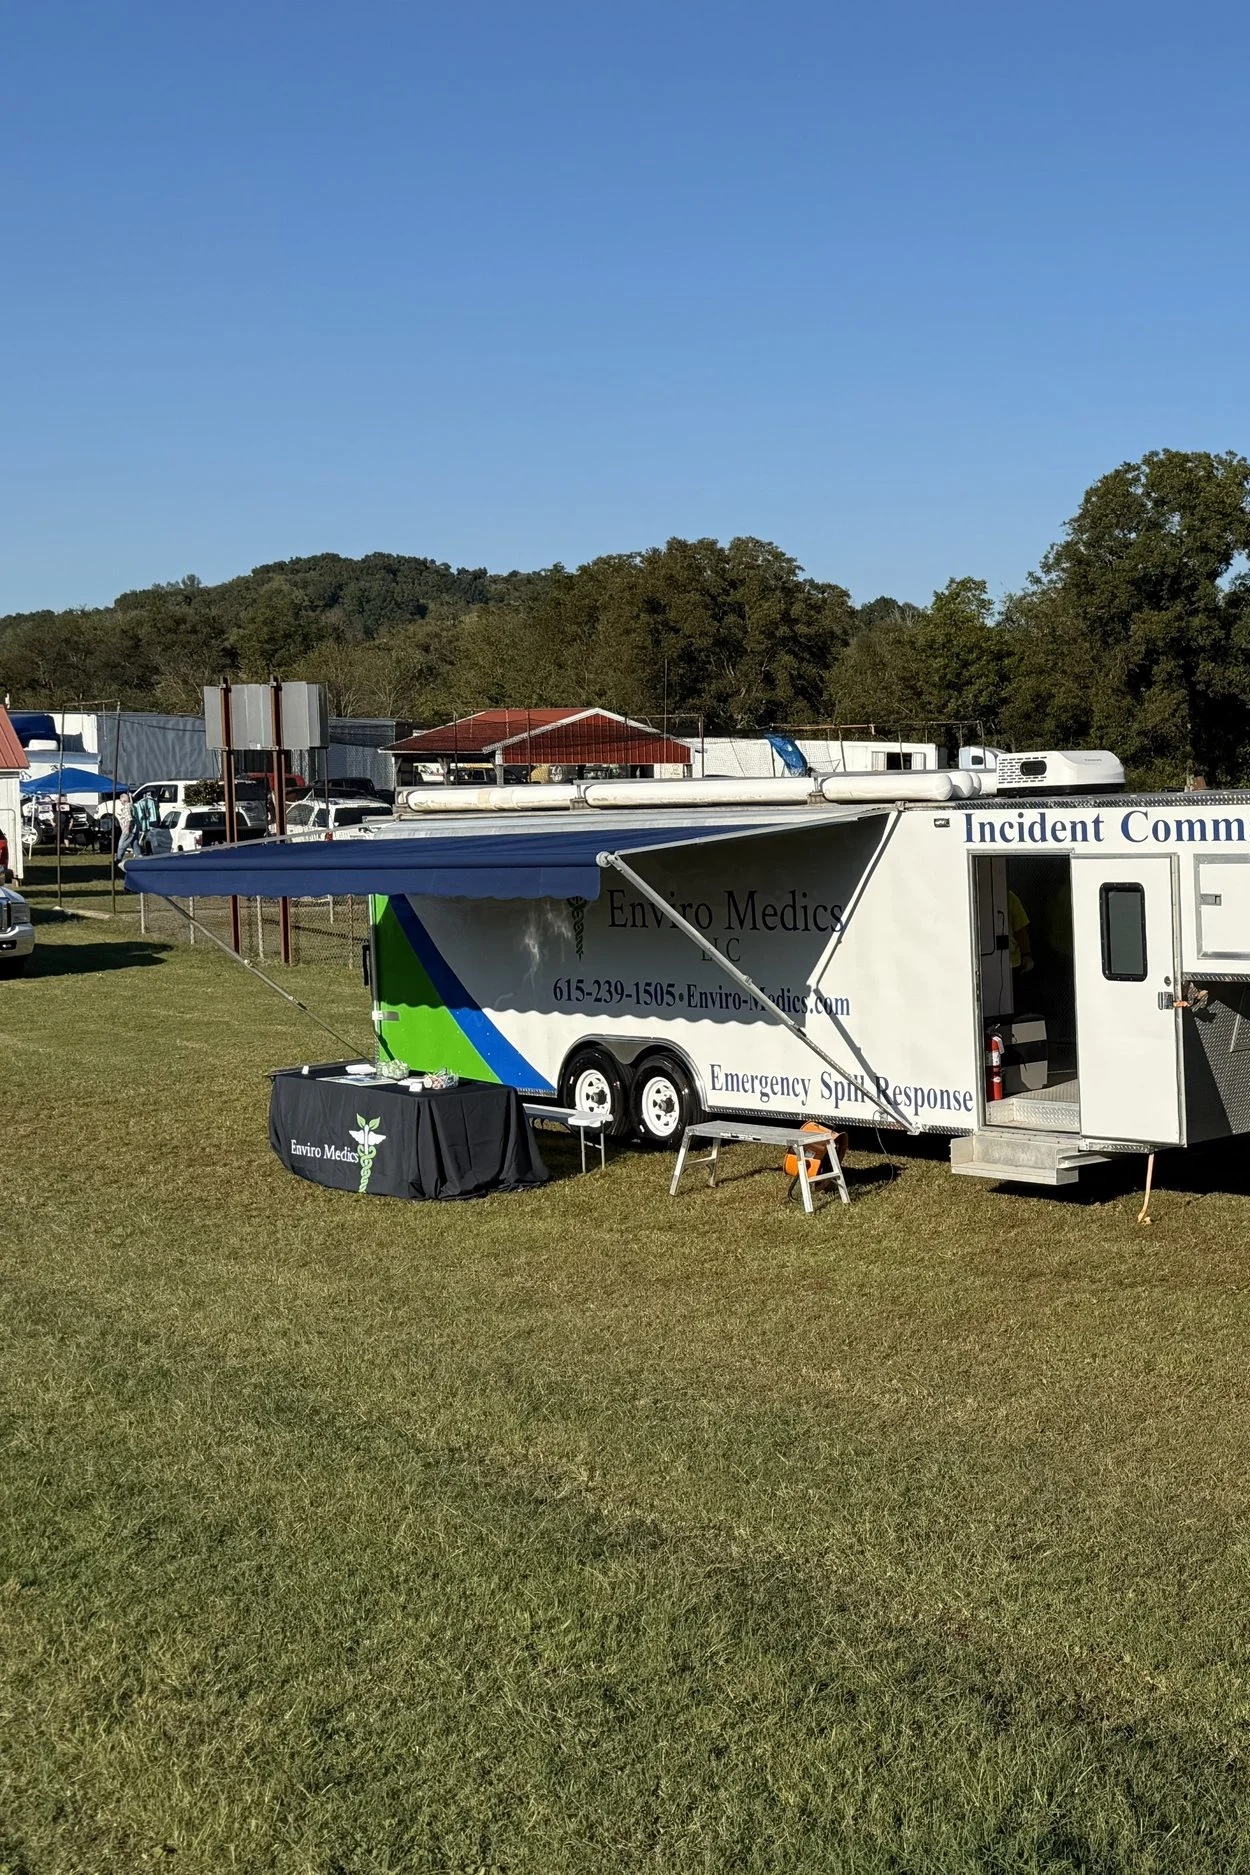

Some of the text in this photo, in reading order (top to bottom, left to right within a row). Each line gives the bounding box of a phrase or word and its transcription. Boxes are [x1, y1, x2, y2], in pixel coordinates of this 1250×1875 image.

[963, 811, 1104, 843] Incident
[607, 888, 844, 932] Enviro Medics
[709, 1063, 974, 1116] Emergency Spill Response
[291, 1139, 359, 1164] Enviro Medics
